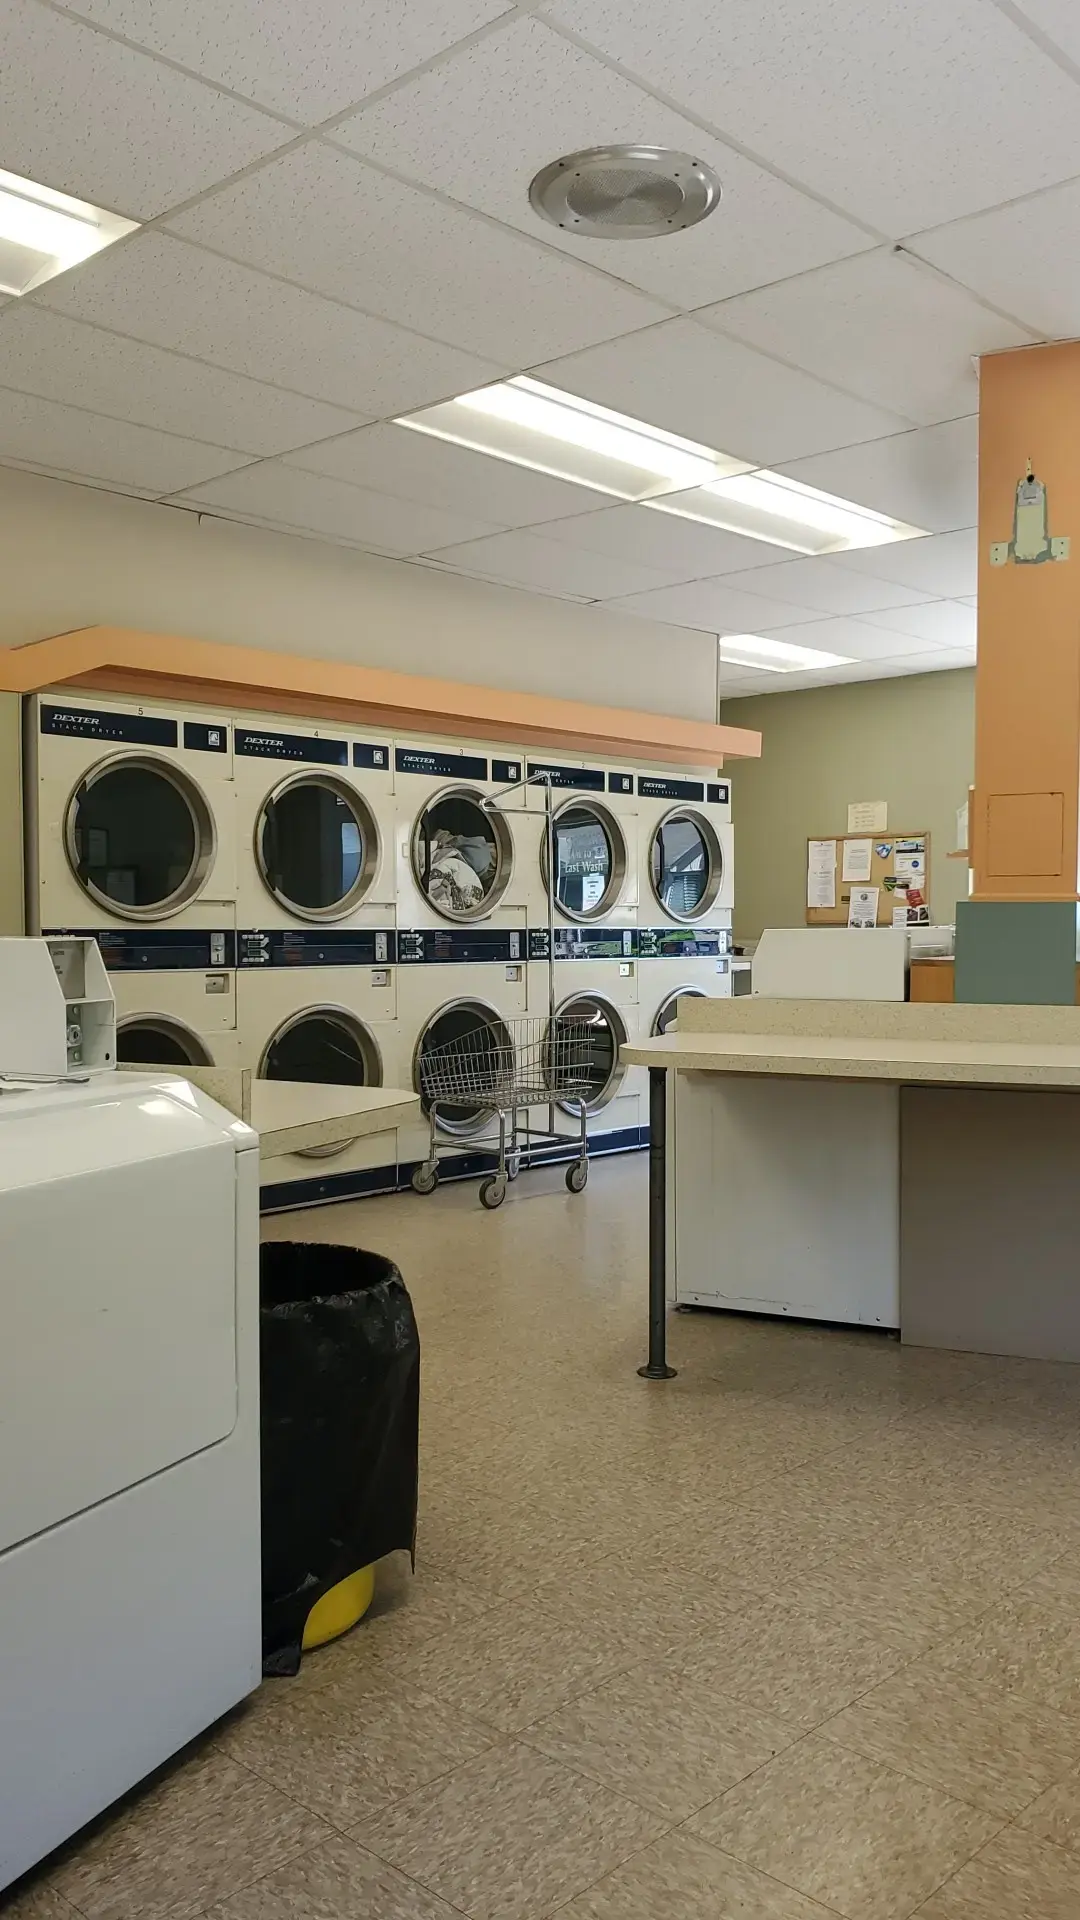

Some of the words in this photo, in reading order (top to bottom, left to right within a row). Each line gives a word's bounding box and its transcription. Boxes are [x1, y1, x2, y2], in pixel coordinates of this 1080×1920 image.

[138, 707, 144, 716] 5
[52, 713, 100, 725] DEXTER
[51, 723, 84, 731] STACK
[91, 727, 124, 735] DRYER
[314, 730, 319, 738] 4
[243, 736, 285, 747] DEXTER
[243, 745, 271, 753] STACK
[459, 748, 464, 756] 3
[403, 755, 436, 764] DEXTER
[565, 862, 580, 873] Last
[581, 859, 604, 872] Wash
